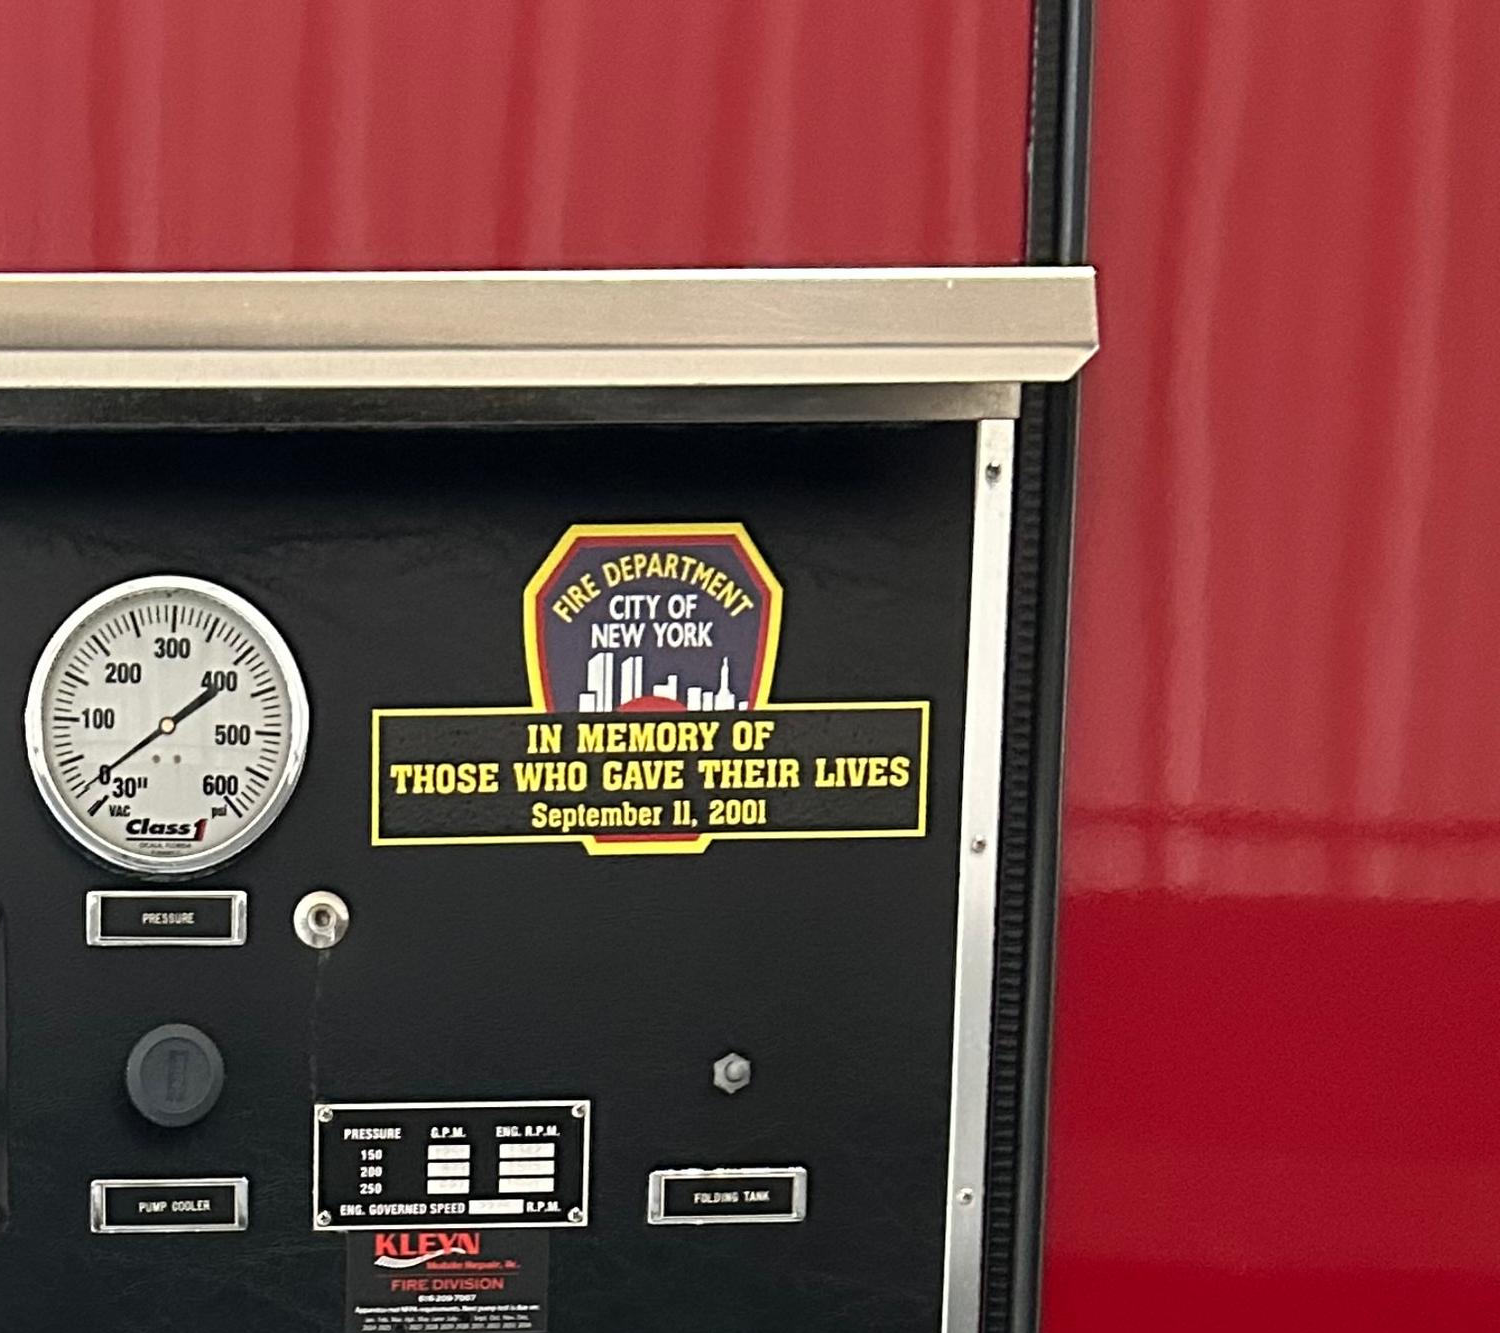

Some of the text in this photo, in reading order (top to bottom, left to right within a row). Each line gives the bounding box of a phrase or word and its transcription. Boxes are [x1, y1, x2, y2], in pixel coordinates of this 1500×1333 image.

[552, 552, 755, 624] FIRE DEPARTMENT
[609, 594, 698, 621] CITY OF
[591, 622, 713, 649] NEW YORK
[154, 637, 191, 659] 300
[105, 662, 142, 684] 200
[201, 670, 238, 692] 400
[81, 708, 115, 730] 100
[215, 724, 251, 746] 500
[527, 721, 774, 754] IN MEMORY OF
[202, 775, 239, 797] 600
[390, 757, 910, 795] THOSE WHO GAVE THEIR LIVES
[109, 804, 131, 818] VAC
[211, 804, 228, 819] psi
[532, 799, 767, 833] September 11, 2001
[142, 911, 195, 925] PRESSURE
[343, 1128, 401, 1140] PRESSURE
[430, 1126, 467, 1139] G.P.M.
[495, 1126, 522, 1137] ENG.
[360, 1149, 383, 1160] 150
[360, 1166, 383, 1177] 200
[360, 1183, 383, 1195] 250
[694, 1190, 770, 1204] FOLDING TANK
[138, 1200, 211, 1213] PUMP COOLER
[340, 1205, 366, 1216] ENG.
[369, 1204, 427, 1215] GOVERNED
[430, 1203, 465, 1214] SPEED
[391, 1277, 505, 1291] FIRE DIVISION
